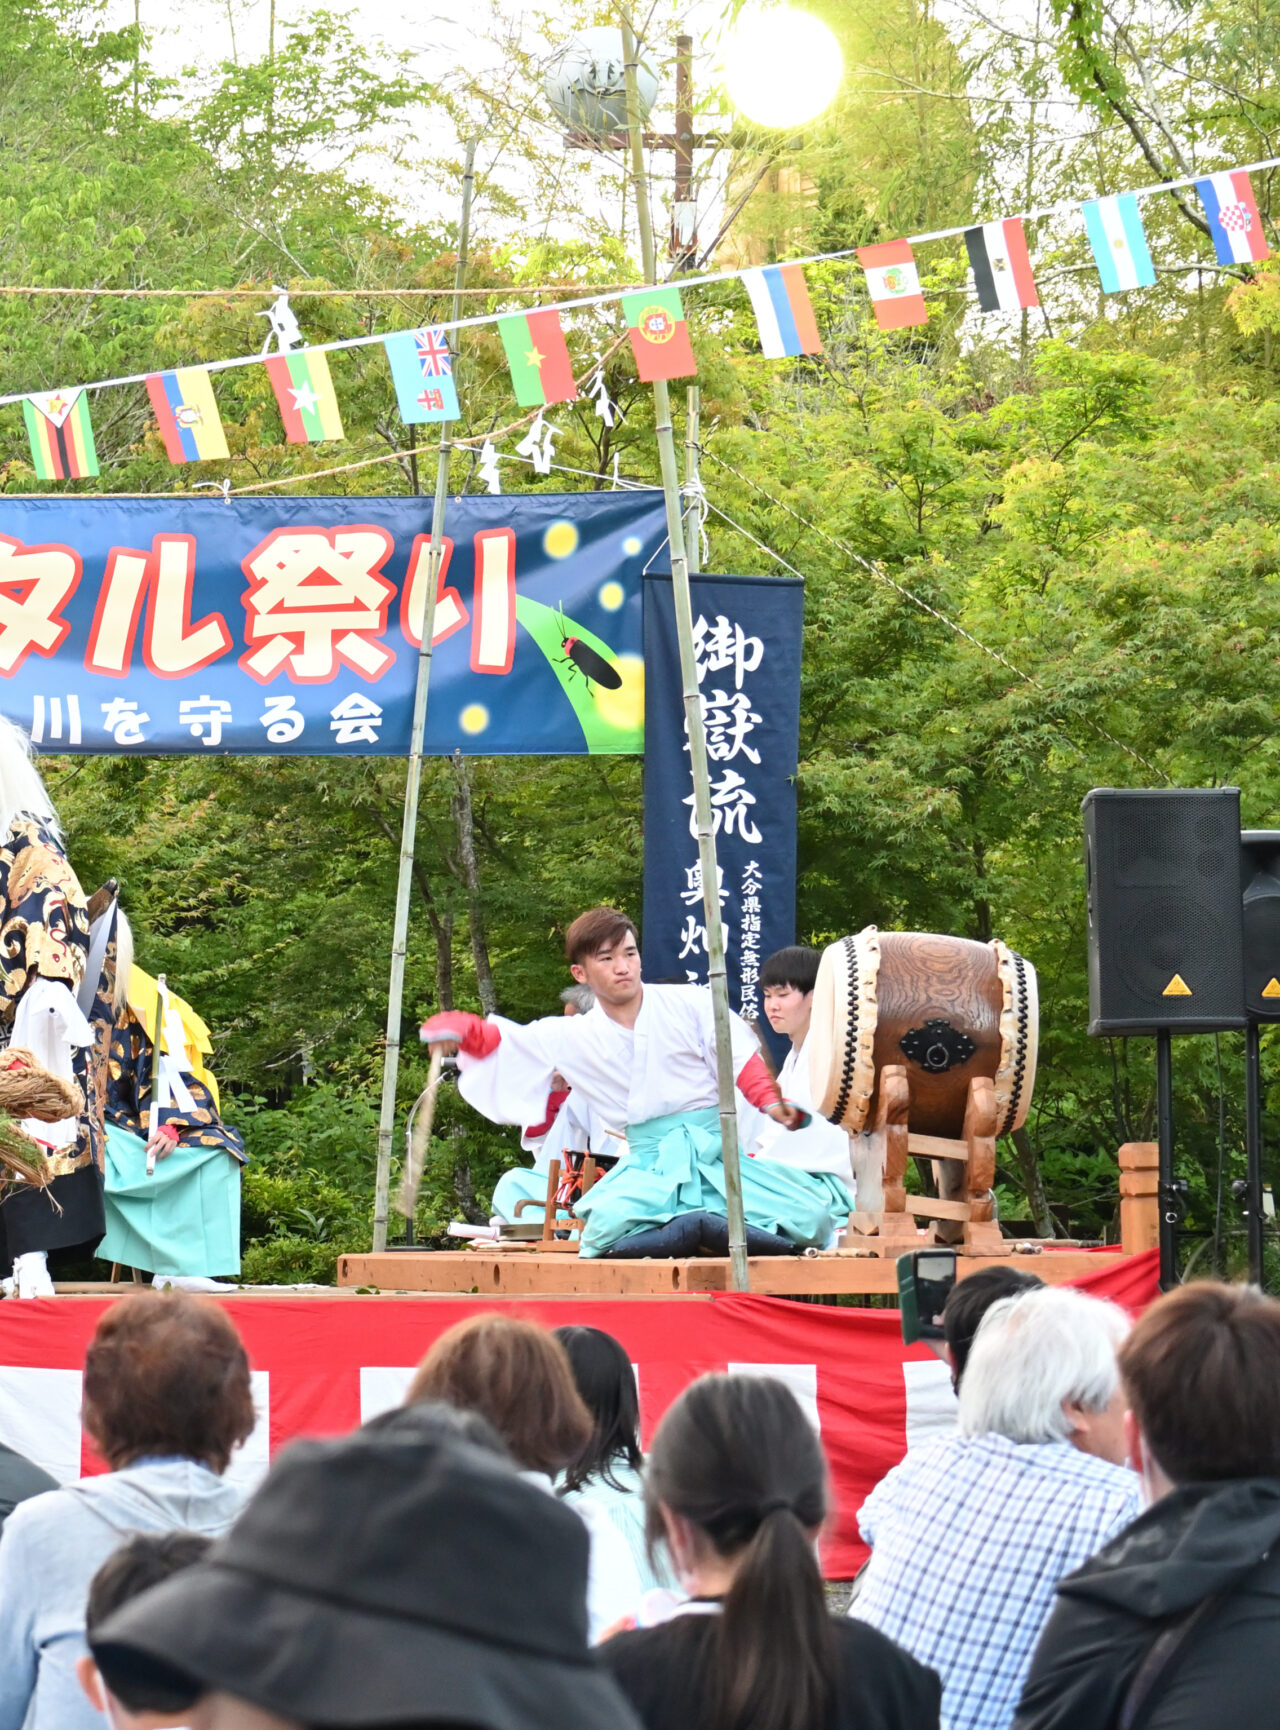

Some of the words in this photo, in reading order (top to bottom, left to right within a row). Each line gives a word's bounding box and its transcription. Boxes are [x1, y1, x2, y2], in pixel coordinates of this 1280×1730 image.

[678, 614, 765, 989] 御嶽流奥畑
[738, 860, 763, 1025] 大分県指定無形民俗
